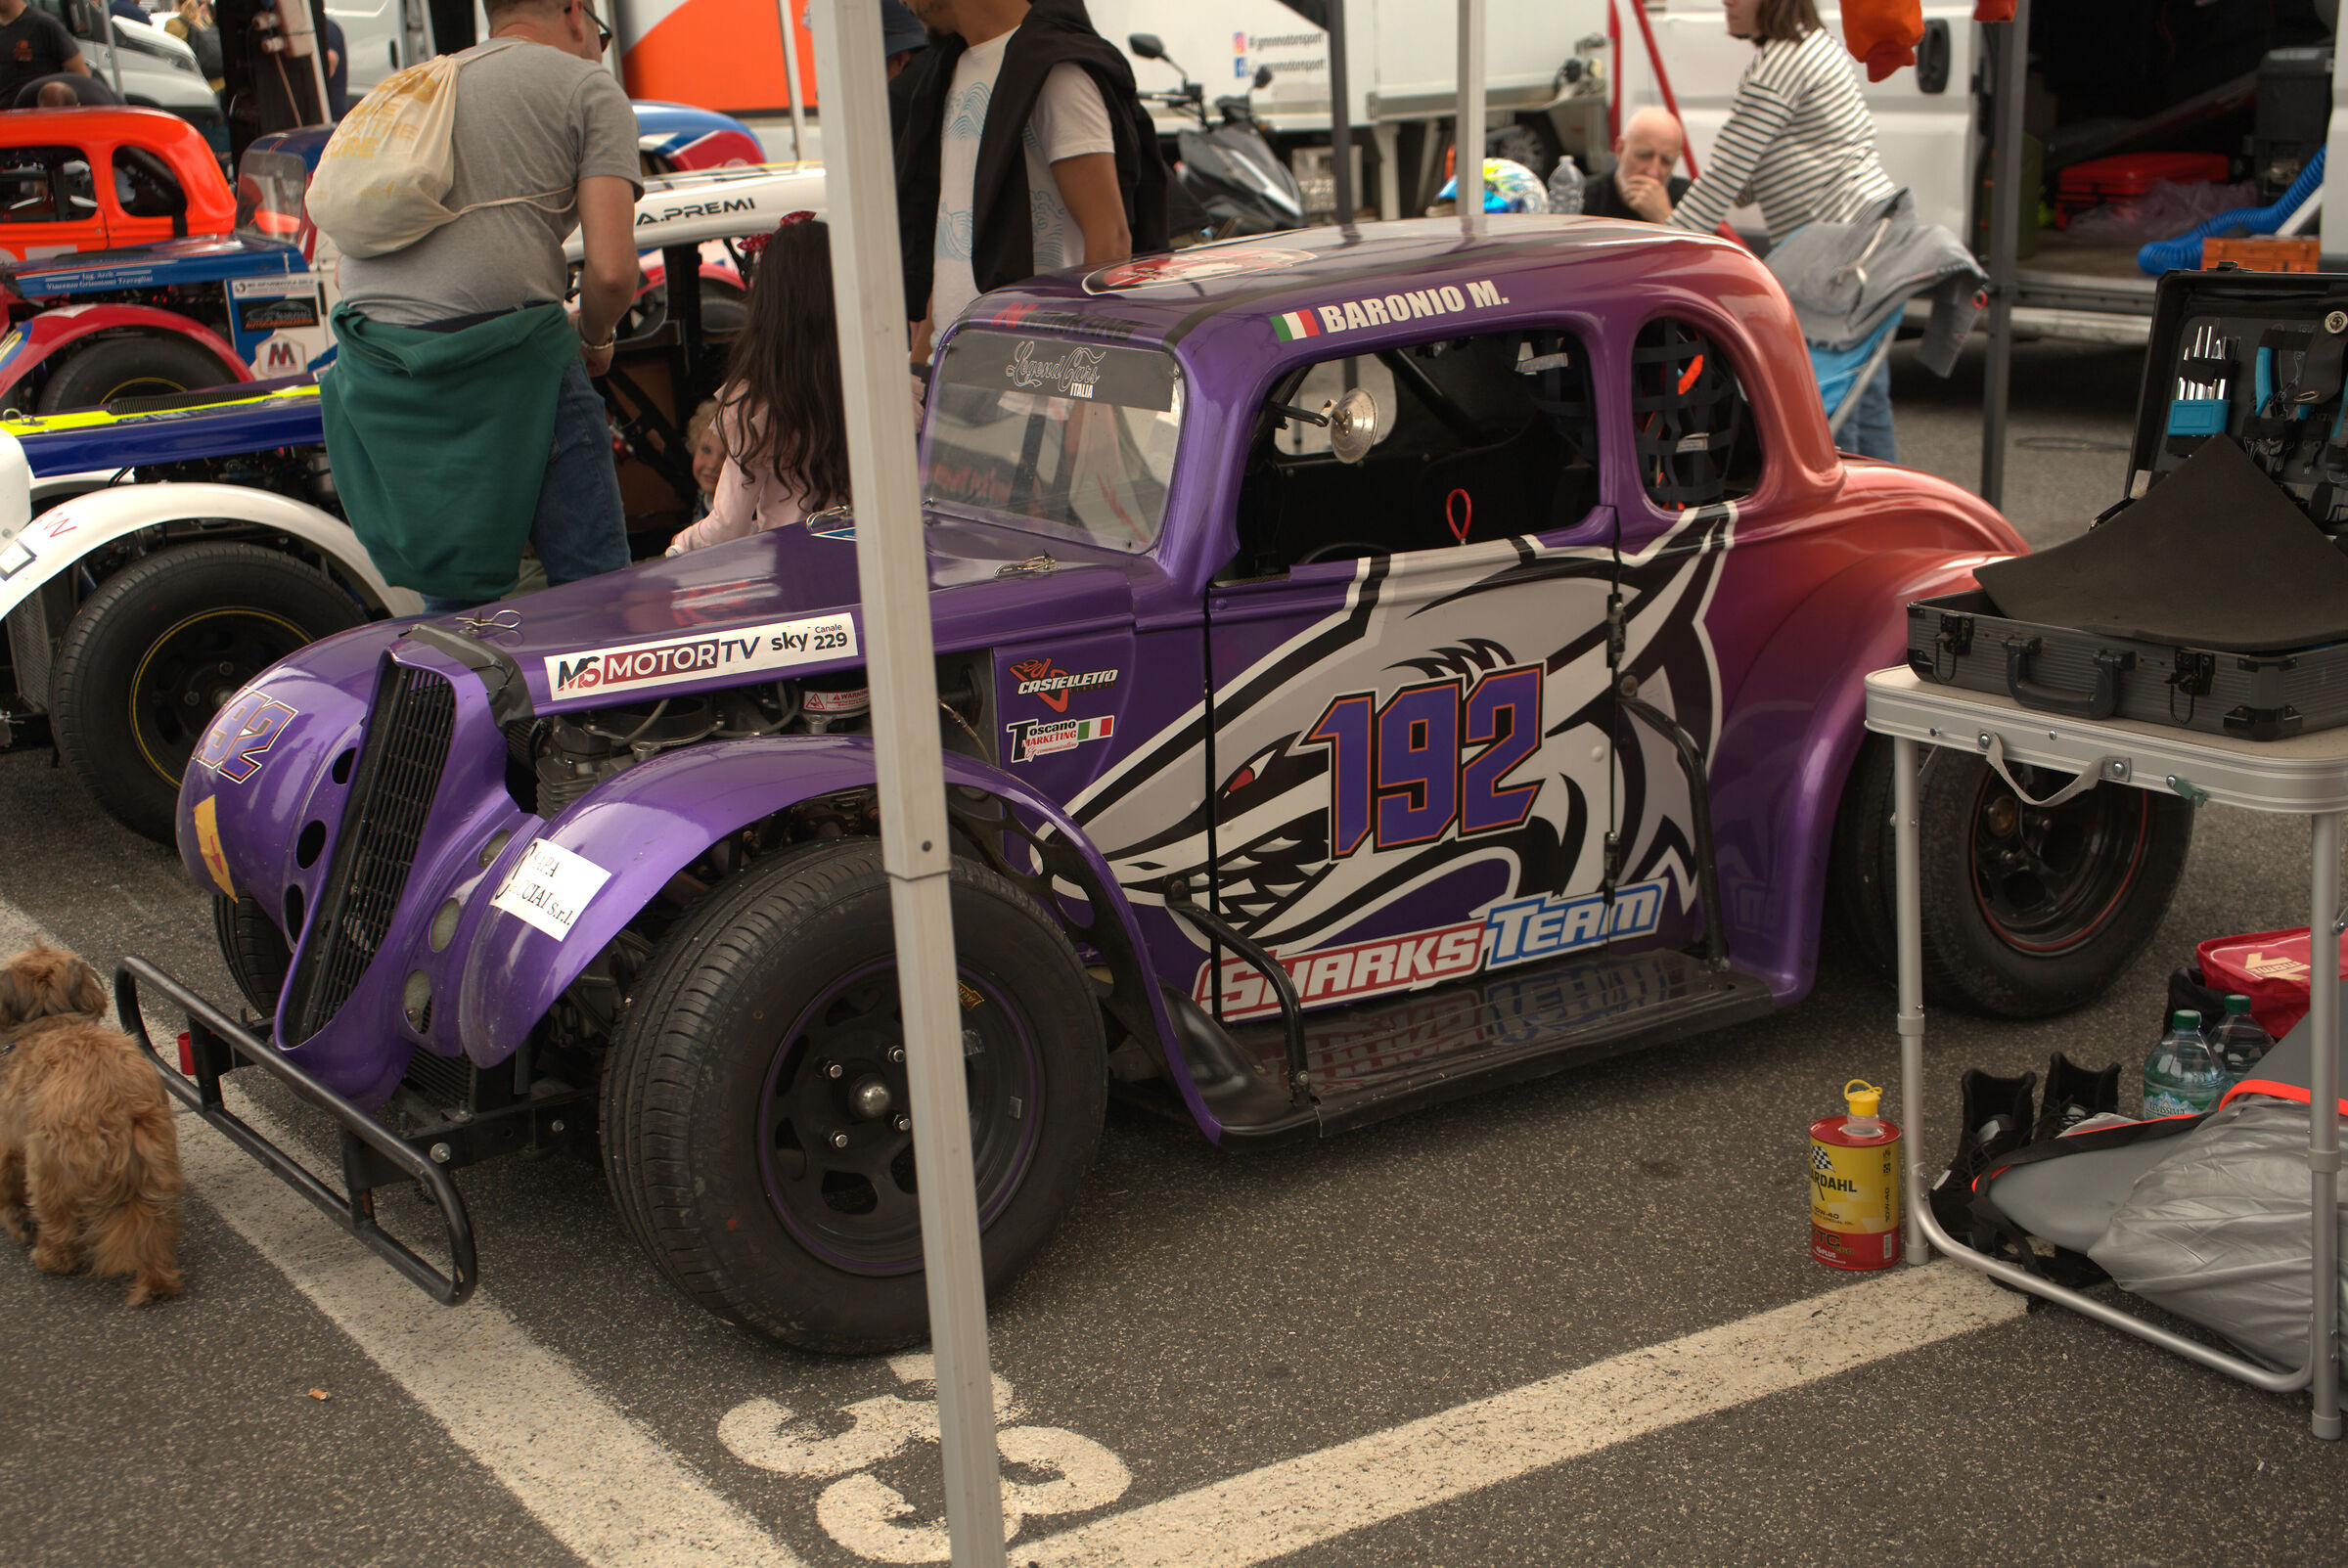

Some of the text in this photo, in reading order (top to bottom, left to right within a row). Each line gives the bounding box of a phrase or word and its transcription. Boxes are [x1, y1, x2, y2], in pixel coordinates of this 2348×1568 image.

[372, 117, 419, 141] THE
[636, 197, 756, 226] A.PREMI
[1318, 280, 1510, 334] BARONIO M.
[1069, 382, 1094, 399] ITALIA
[814, 623, 843, 634] Canale
[814, 632, 848, 650] 229
[771, 631, 809, 652] sky
[1017, 669, 1118, 695] CASTELLETTO
[196, 689, 298, 784] 92
[1021, 730, 1077, 749] MARKETING
[1298, 661, 1547, 863] 192
[1491, 887, 1661, 964] TEAM
